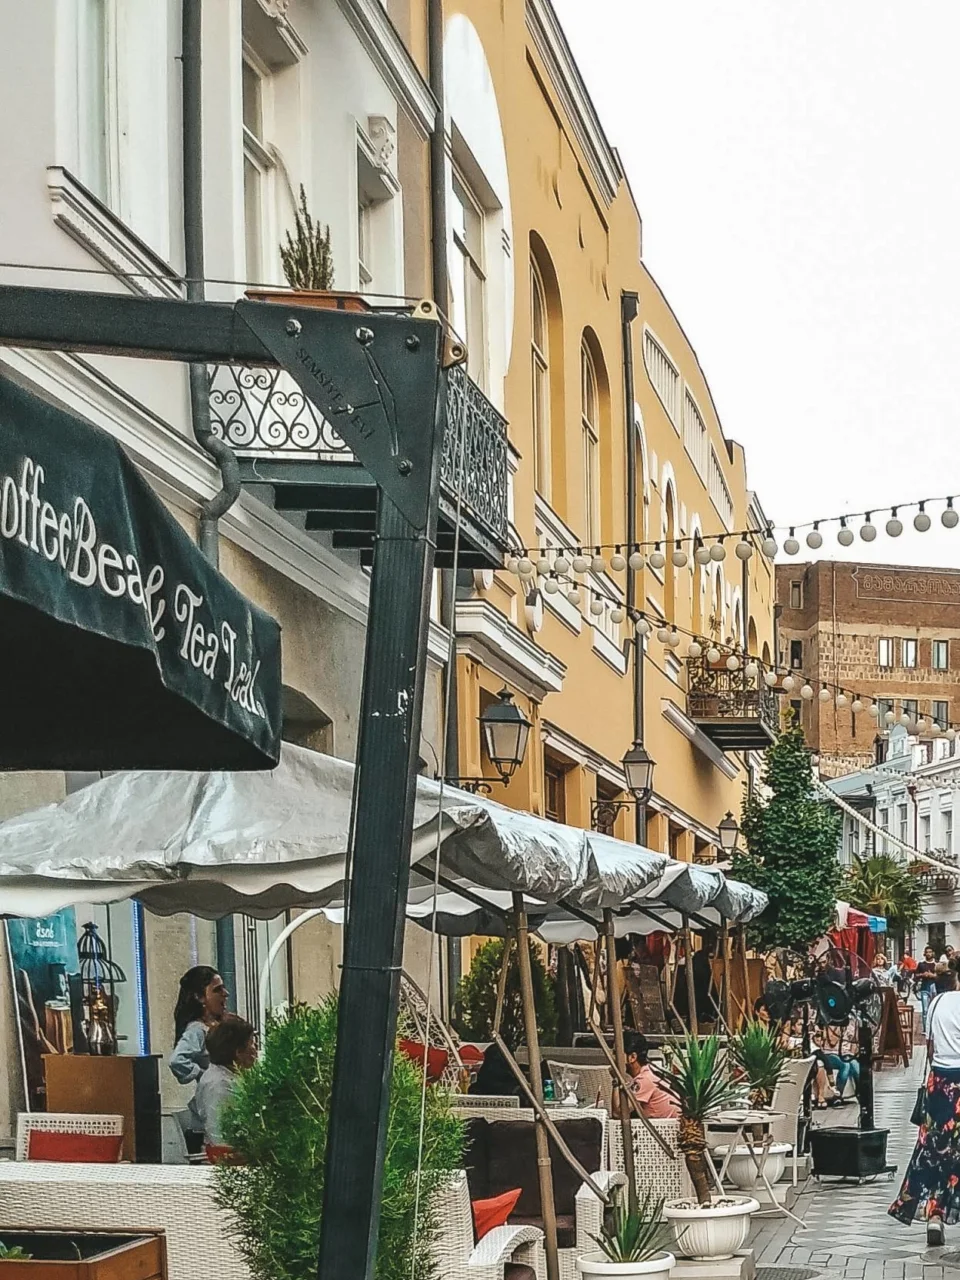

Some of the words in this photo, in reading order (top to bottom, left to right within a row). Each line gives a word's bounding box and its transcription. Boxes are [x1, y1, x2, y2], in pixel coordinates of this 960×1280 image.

[0, 457, 72, 569] offee
[69, 496, 147, 610] Bea
[175, 584, 219, 680] Tea
